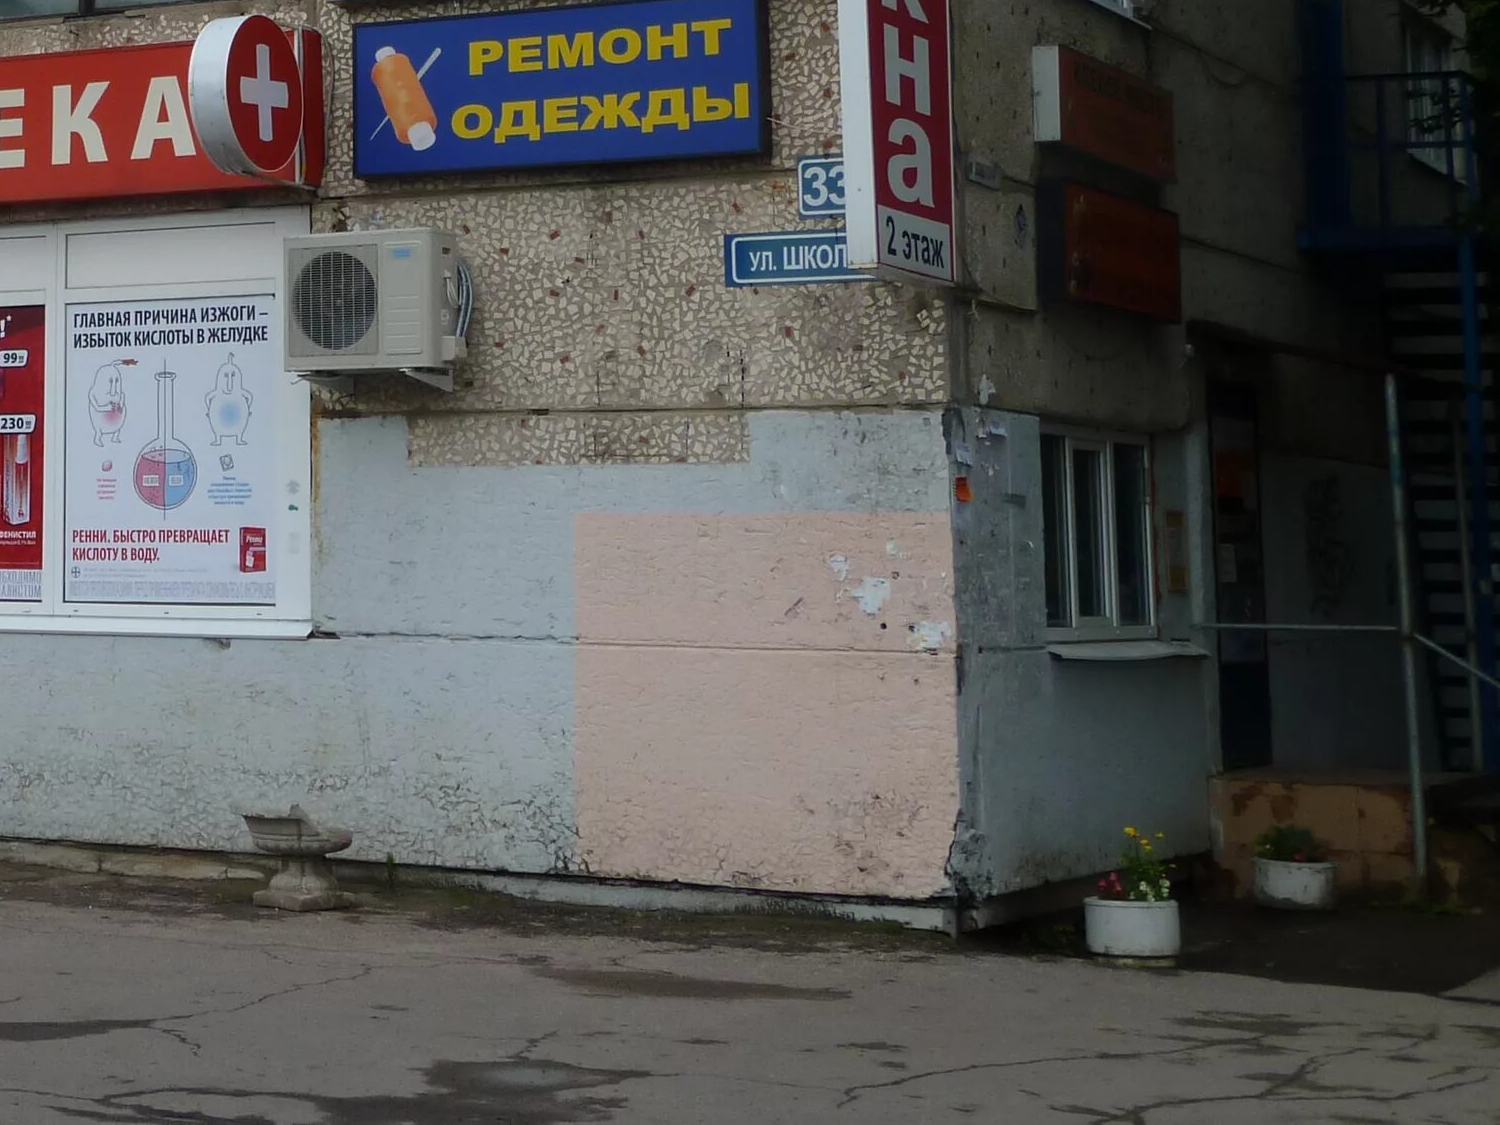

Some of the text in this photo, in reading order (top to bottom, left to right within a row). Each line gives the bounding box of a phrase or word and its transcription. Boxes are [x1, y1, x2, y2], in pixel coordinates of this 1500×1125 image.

[467, 17, 732, 76] РЕМОНТ
[451, 82, 750, 144] ОДЕЖДЫ
[886, 215, 945, 268] 2 этаж
[749, 251, 777, 272] ул.
[74, 311, 131, 328] ГЛАВНАЯ
[134, 308, 197, 326] ПРИЧИНА
[201, 305, 256, 323] ИЗЖОГИ
[74, 325, 268, 348] ИЗБЫТОК КИСЛОТЫ В ЖЕЛУДКЕ
[3, 352, 18, 364] 99
[0, 417, 24, 430] 230
[73, 529, 230, 545] РЕННИ. БЫСТРО ПРЕВРАЩАЕТ
[73, 547, 160, 564] КИСЛОТУ В ВОДУ.
